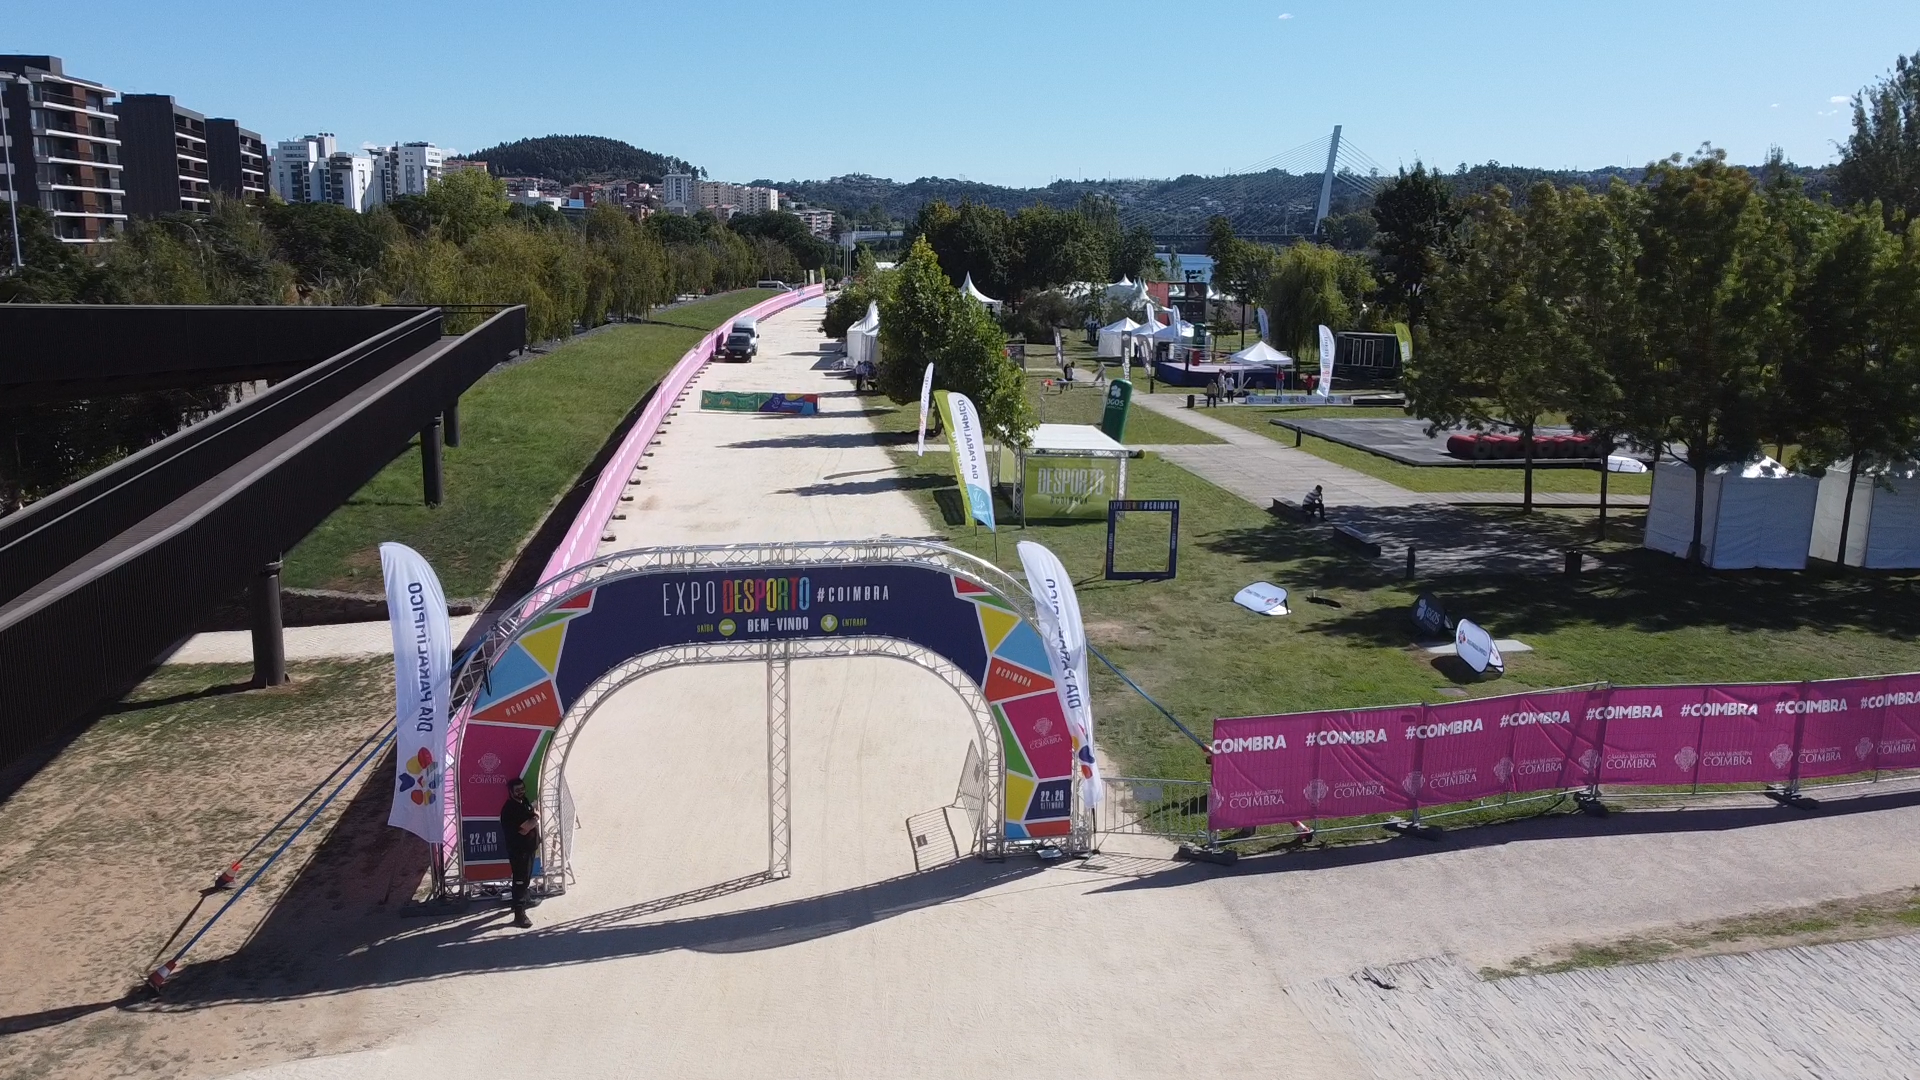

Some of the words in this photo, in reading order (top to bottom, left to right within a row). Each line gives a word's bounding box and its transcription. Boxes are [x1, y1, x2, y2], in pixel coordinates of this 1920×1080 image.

[1038, 467, 1105, 496] DESPORTO
[662, 580, 716, 617] EXPO
[722, 576, 810, 614] DESPORTO
[816, 585, 890, 603] #COIMBRA
[747, 616, 809, 633] BEM-VINDO
[995, 666, 1032, 688] #COIMBRA
[505, 692, 547, 717] #COIMBRA
[1680, 702, 1758, 717] #COIMBRA
[1774, 698, 1848, 715] #COIMBRA
[1500, 710, 1571, 728] #COIMBRA
[1585, 705, 1664, 721] #COIMBRA
[1404, 718, 1483, 740] #COIMBRA
[1305, 728, 1387, 747] #COIMBRA
[1876, 743, 1917, 755] COIMBRA
[1606, 758, 1657, 769] COIMBRA
[1702, 756, 1753, 767] COIMBRA
[1798, 752, 1841, 764] COIMBRA
[1518, 762, 1562, 776] COIMBRA
[1429, 774, 1477, 789] COIMBRA
[1040, 790, 1050, 802] 22
[1333, 785, 1385, 799] COIMBRA
[1229, 794, 1285, 809] COIMBRA
[470, 833, 480, 845] 22
